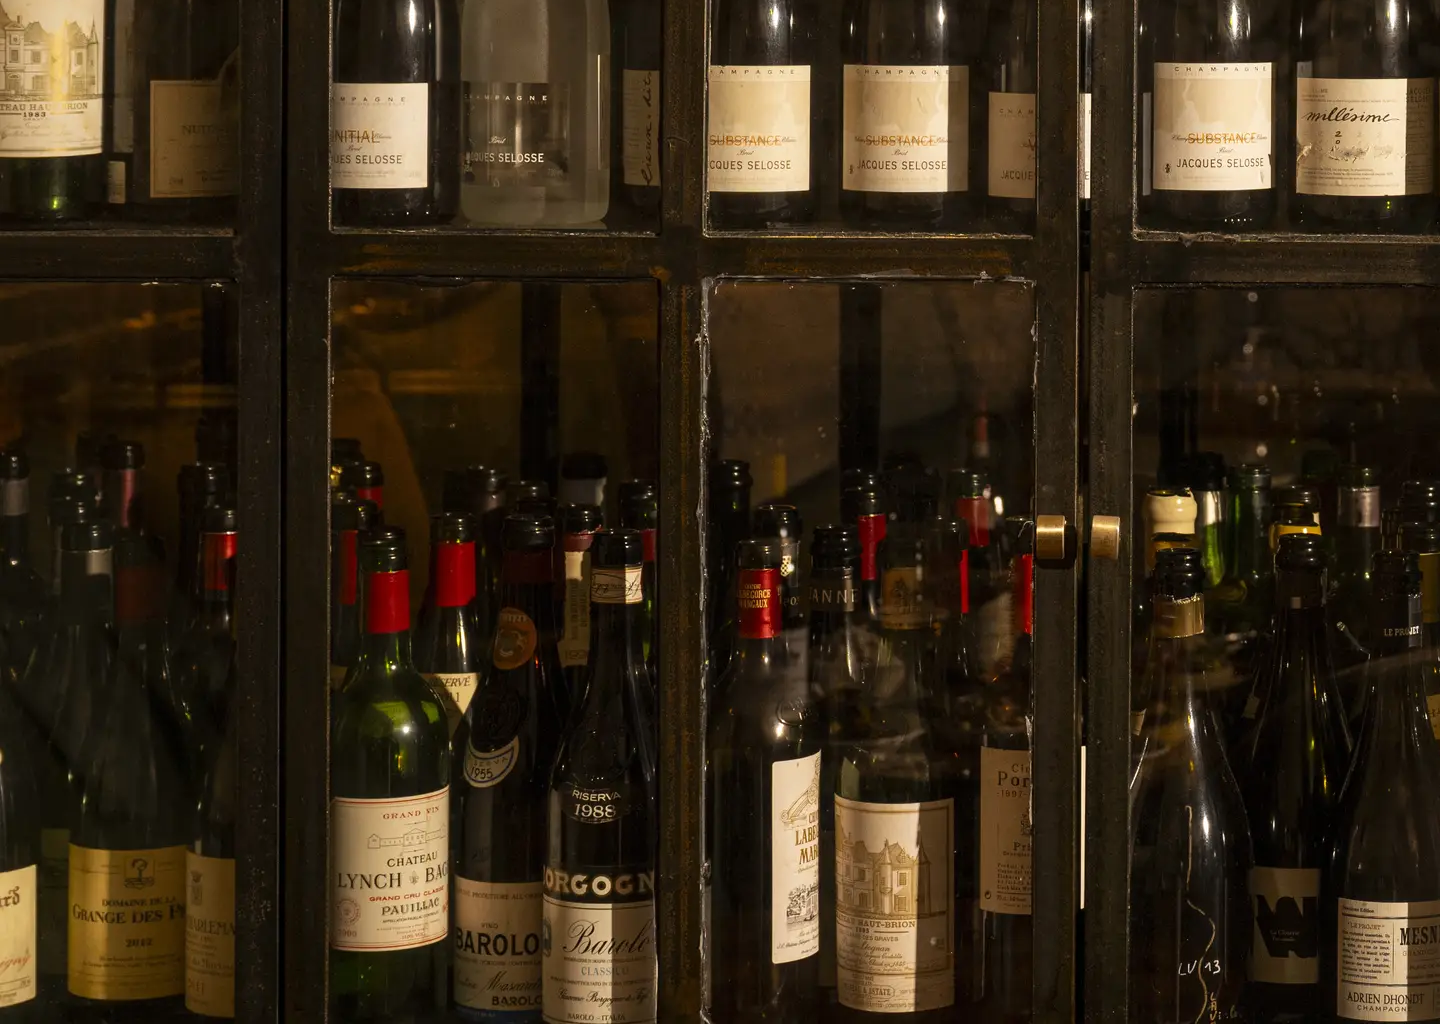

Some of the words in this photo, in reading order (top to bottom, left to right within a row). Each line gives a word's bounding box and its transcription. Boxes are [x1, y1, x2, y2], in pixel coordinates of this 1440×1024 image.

[1300, 106, 1400, 123] millésime
[709, 135, 782, 147] SUBSTANCE
[865, 134, 937, 147] SUBSTANCE
[1187, 132, 1257, 145] SUBSTANCE
[355, 154, 402, 165] SELOSSE
[498, 152, 545, 163] SELOSSE
[1176, 158, 1223, 168] JACQUES
[1226, 158, 1264, 168] SELOSSE
[747, 160, 792, 170] SELOSSE
[856, 160, 898, 171] JACQUES
[901, 160, 947, 170] SELOSSE
[470, 765, 494, 779] 1955
[571, 788, 622, 802] RISERVA
[382, 808, 422, 821] GRAND
[426, 805, 440, 816] VIN
[573, 803, 617, 819] 1988
[337, 871, 403, 890] LYNCH
[102, 899, 148, 907] DOMAINE
[368, 894, 401, 903] GRAND
[403, 892, 421, 900] CRU
[381, 898, 440, 917] PAUILLAC
[132, 909, 163, 924] DES
[857, 919, 916, 930] HAUT-BRION
[456, 927, 540, 957] BAROLO
[562, 918, 655, 955] Barolo
[873, 935, 899, 943] GRAVES
[1347, 991, 1382, 1005] ADRIEN
[1384, 993, 1425, 1005] DHONDT
[1357, 1004, 1412, 1013] CHAMPAGNE
